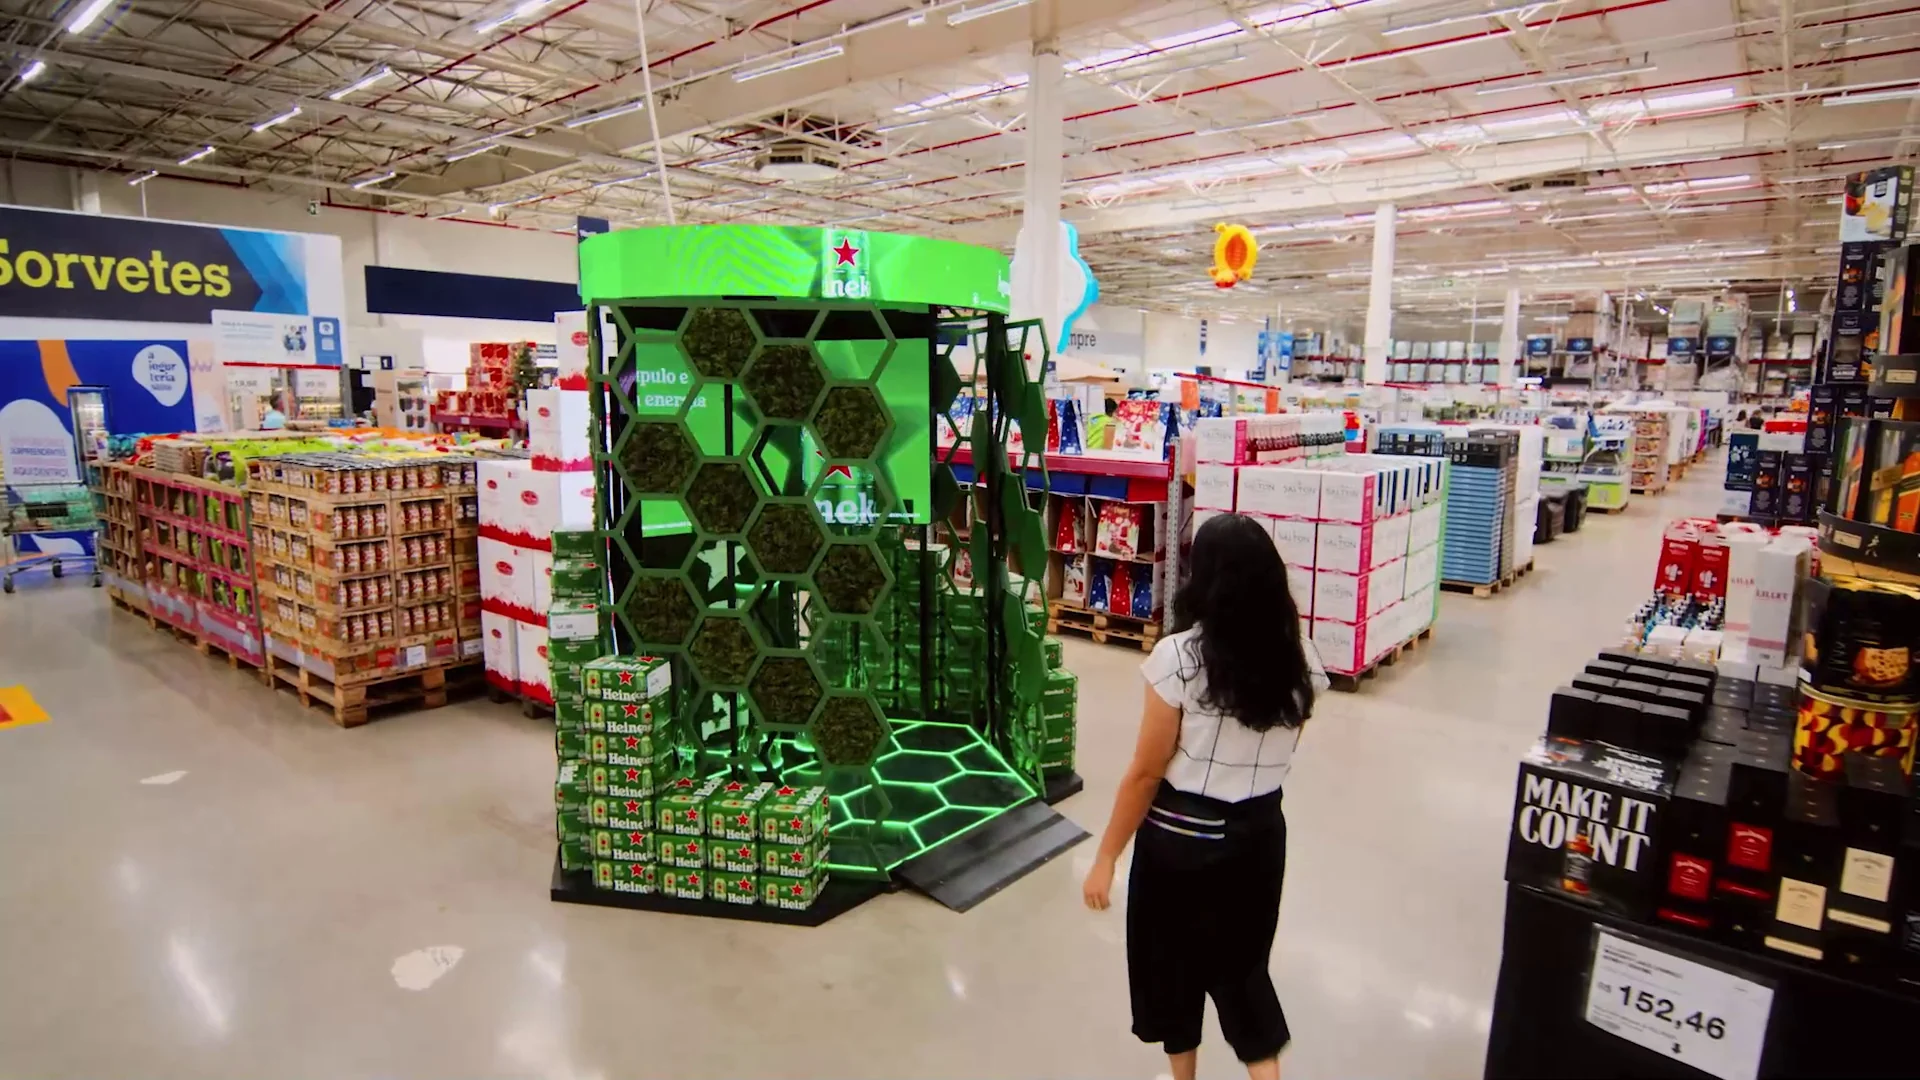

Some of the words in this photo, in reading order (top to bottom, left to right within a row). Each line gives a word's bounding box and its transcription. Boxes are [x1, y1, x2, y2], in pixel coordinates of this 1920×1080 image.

[1522, 773, 1612, 823] MAKE
[1617, 796, 1657, 833] IT
[1619, 984, 1727, 1040] 152,46
